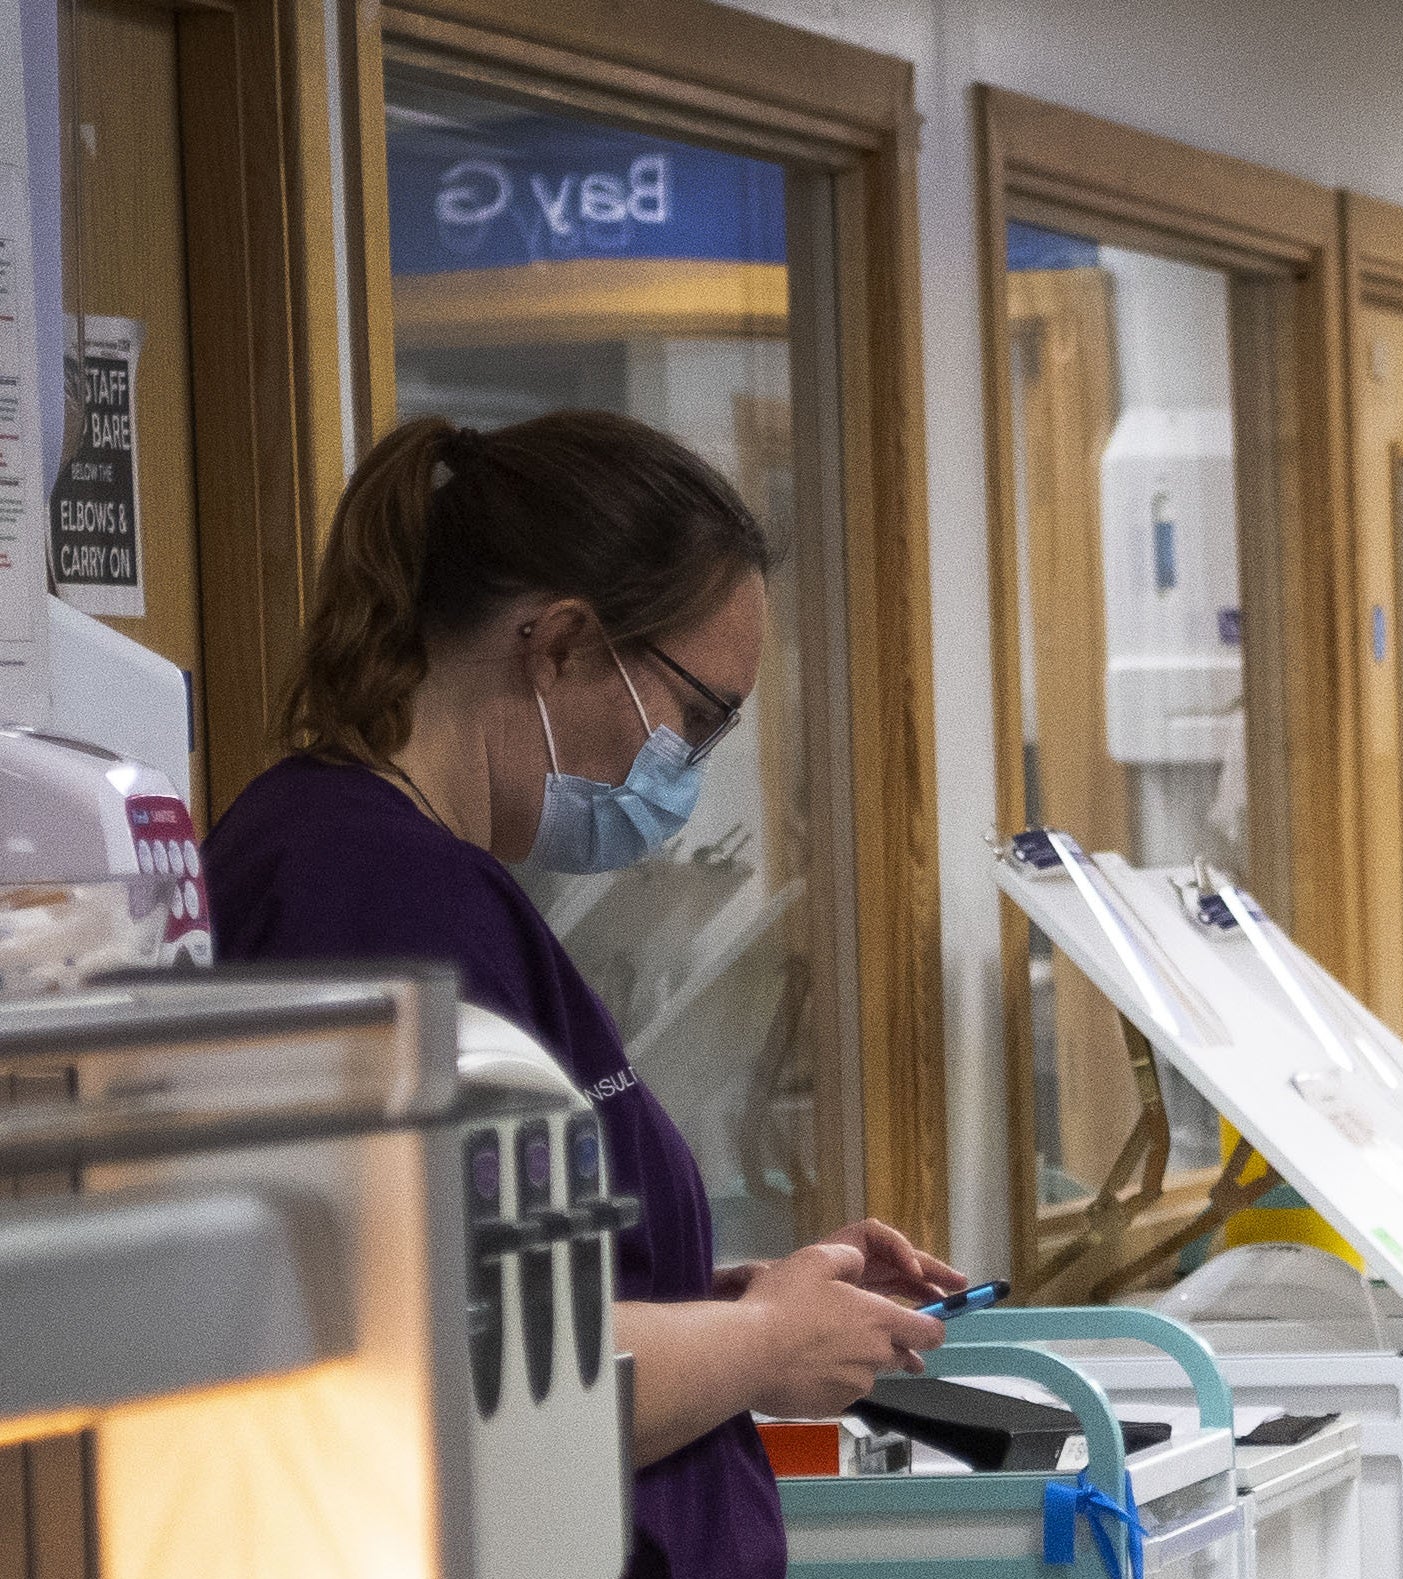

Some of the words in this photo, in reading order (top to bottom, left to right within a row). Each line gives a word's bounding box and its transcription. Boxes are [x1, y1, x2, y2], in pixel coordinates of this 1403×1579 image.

[91, 412, 131, 451] BARE
[60, 499, 115, 534] ELBOWS
[118, 503, 128, 534] &
[60, 544, 106, 577] CARRY
[109, 546, 131, 579] ON
